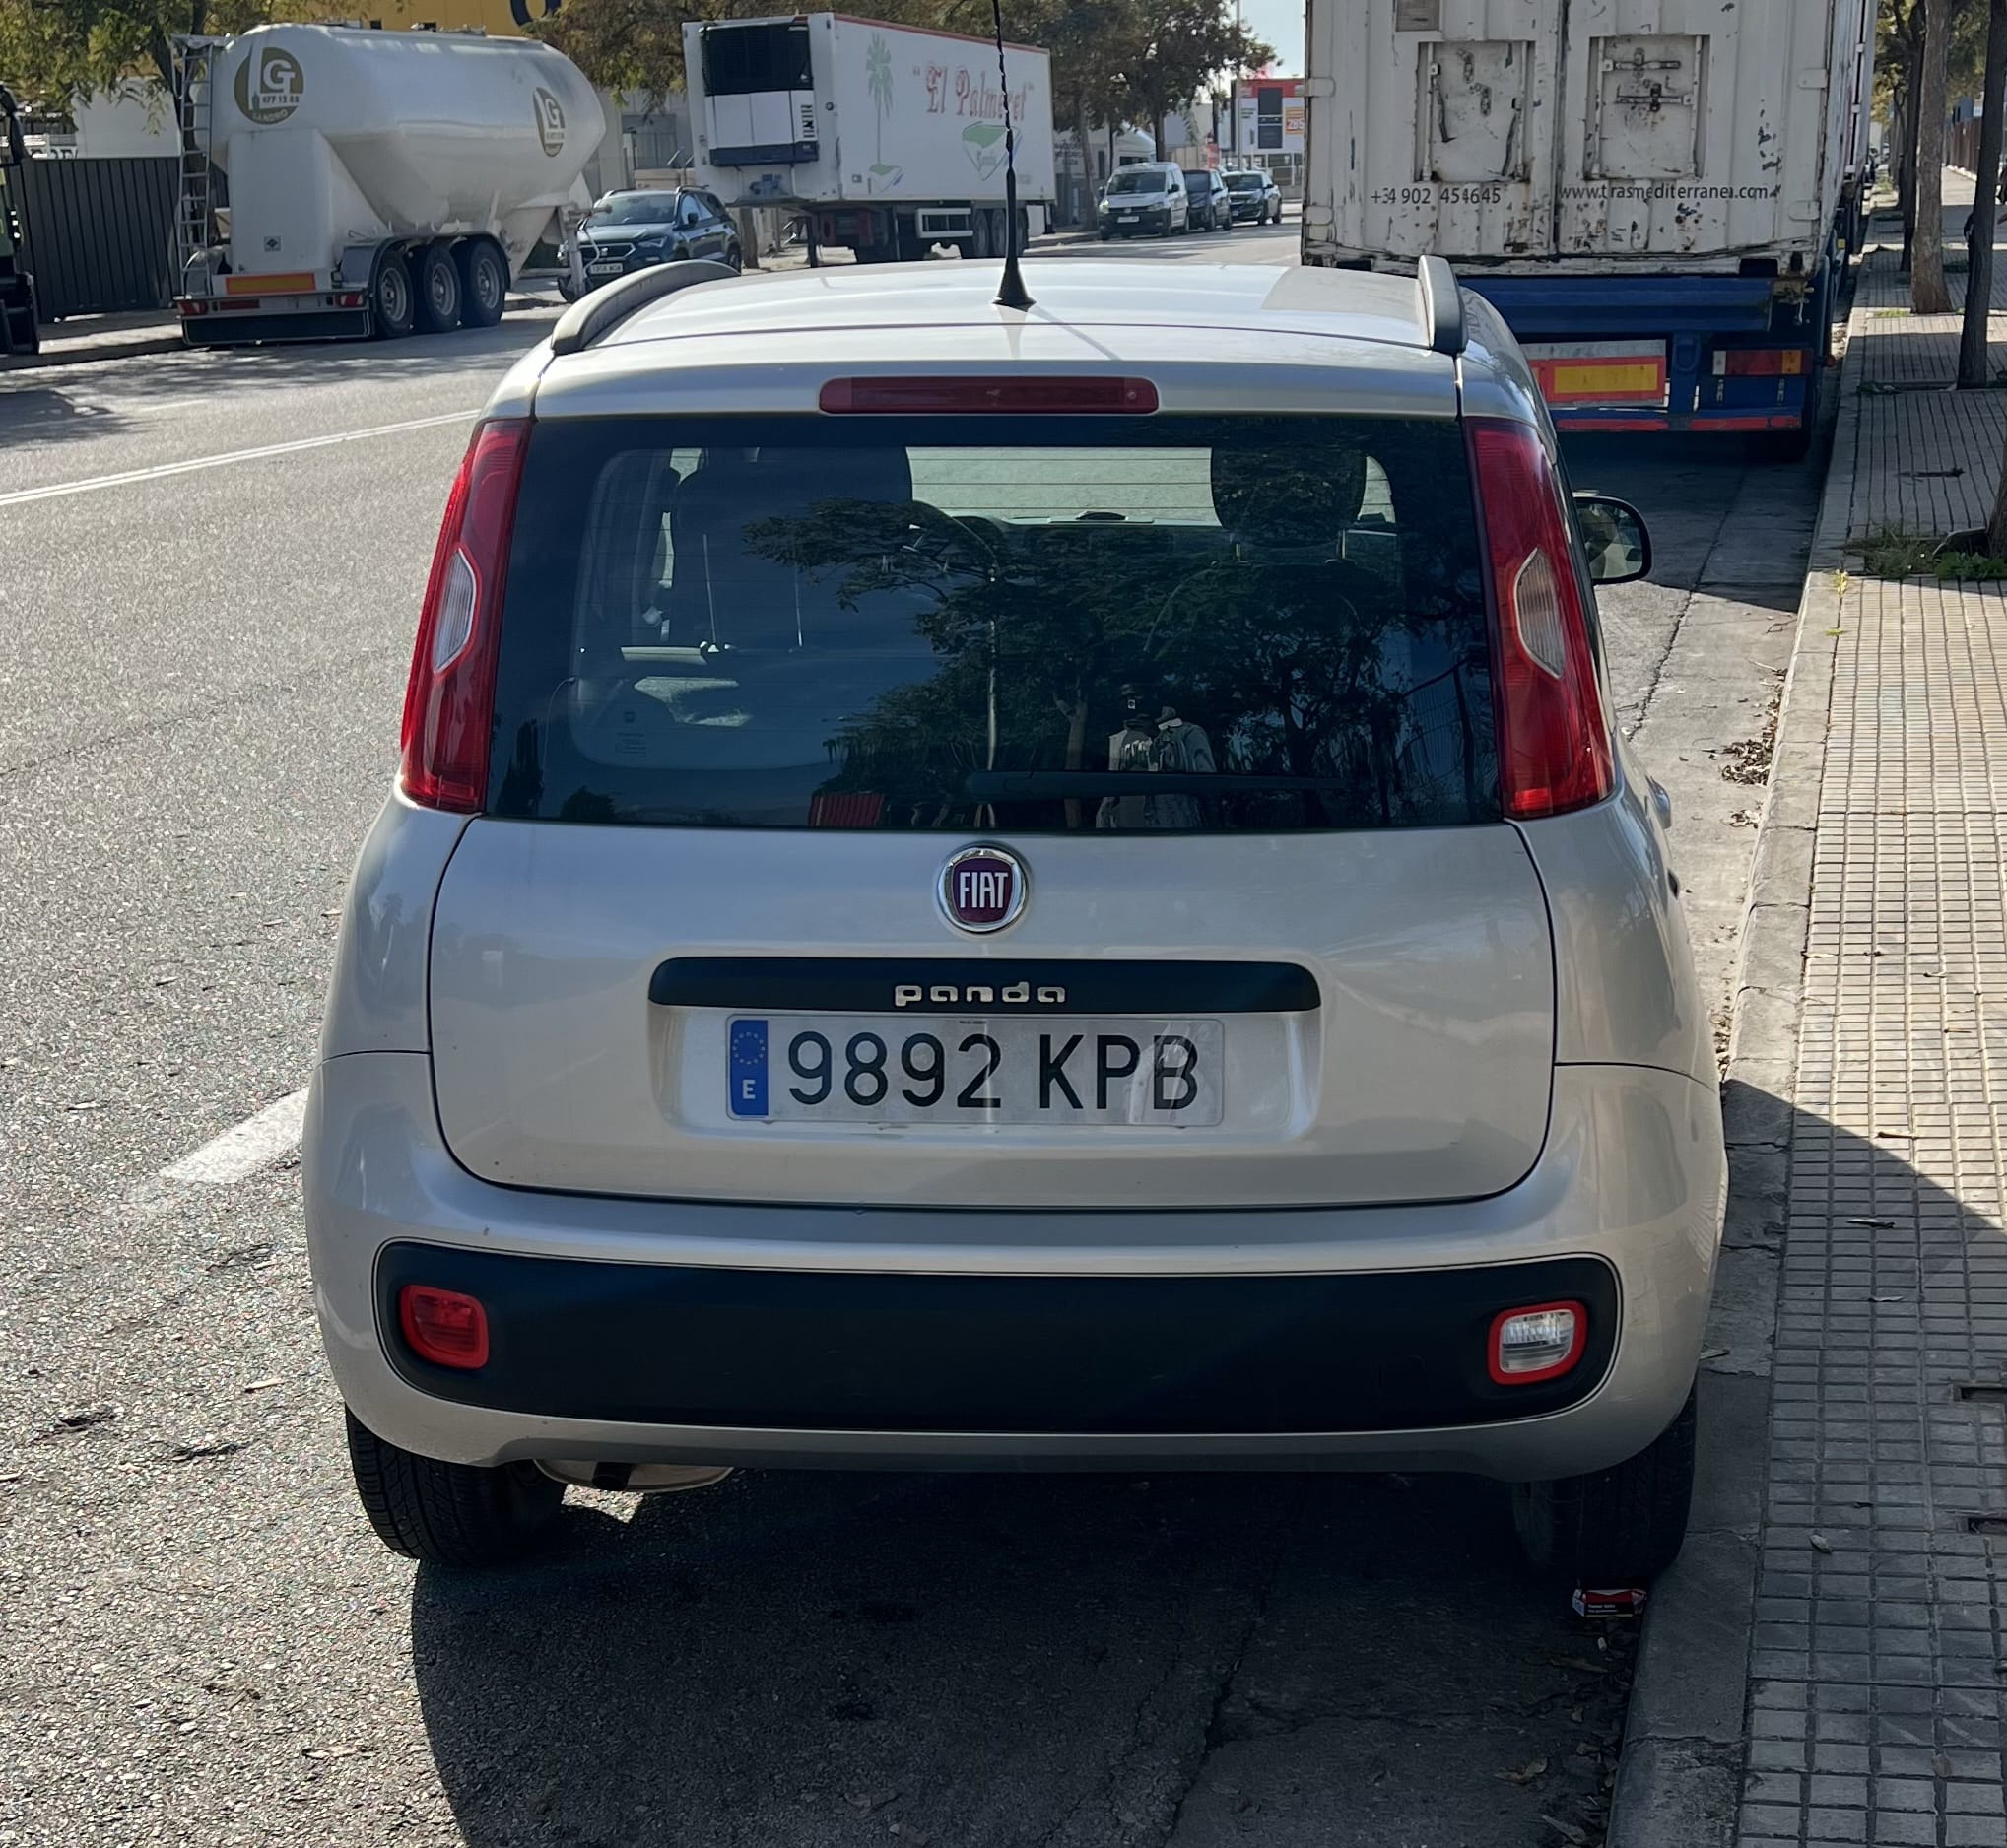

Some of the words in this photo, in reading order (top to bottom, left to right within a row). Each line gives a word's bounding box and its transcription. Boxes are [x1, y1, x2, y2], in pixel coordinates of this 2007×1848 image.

[1401, 187, 1431, 204] 902
[1439, 187, 1502, 204] 454645
[959, 871, 1009, 909] FIAT
[895, 980, 1066, 1007] panda
[788, 1030, 1002, 1109] 9892
[1039, 1034, 1198, 1110] KPB
[742, 1079, 756, 1100] E
